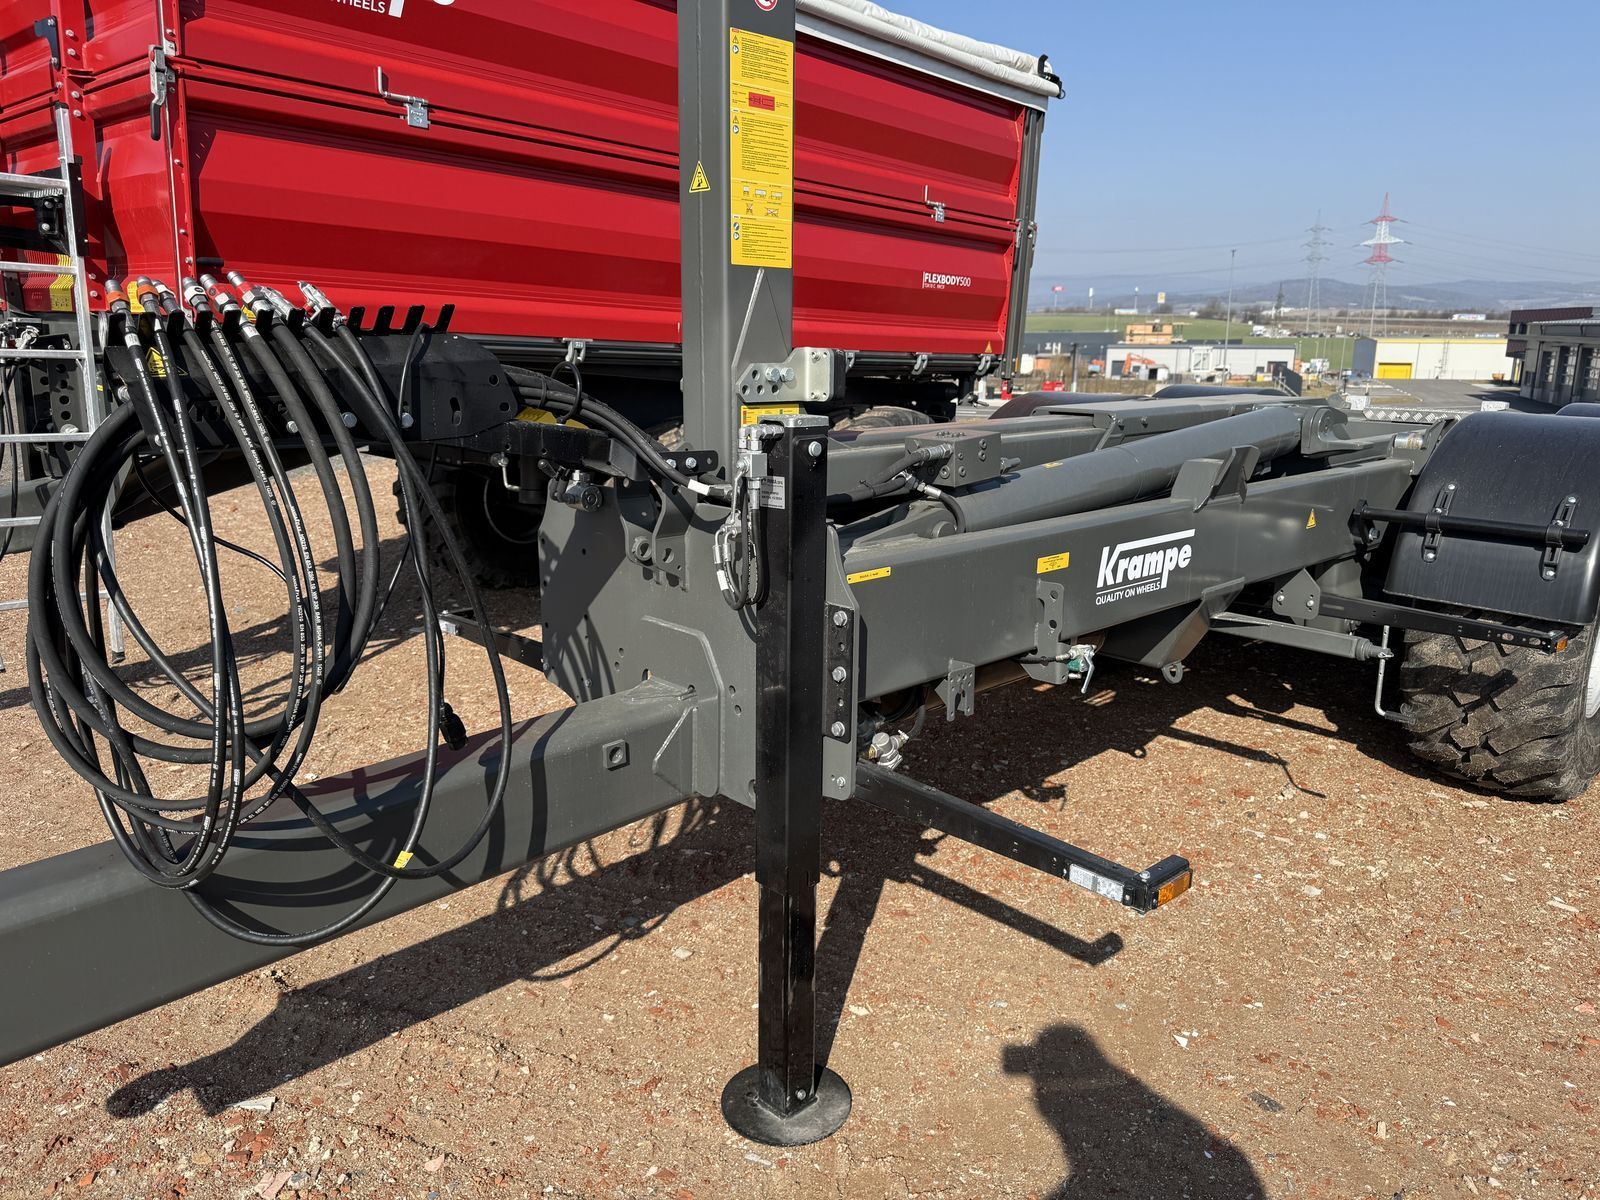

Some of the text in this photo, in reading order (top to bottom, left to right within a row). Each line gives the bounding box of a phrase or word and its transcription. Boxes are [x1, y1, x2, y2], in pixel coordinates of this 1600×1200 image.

[924, 272, 972, 287] FLEXBODY500
[1096, 529, 1196, 589] Krampe
[1095, 581, 1161, 605] QUALITY ON WHEELS
